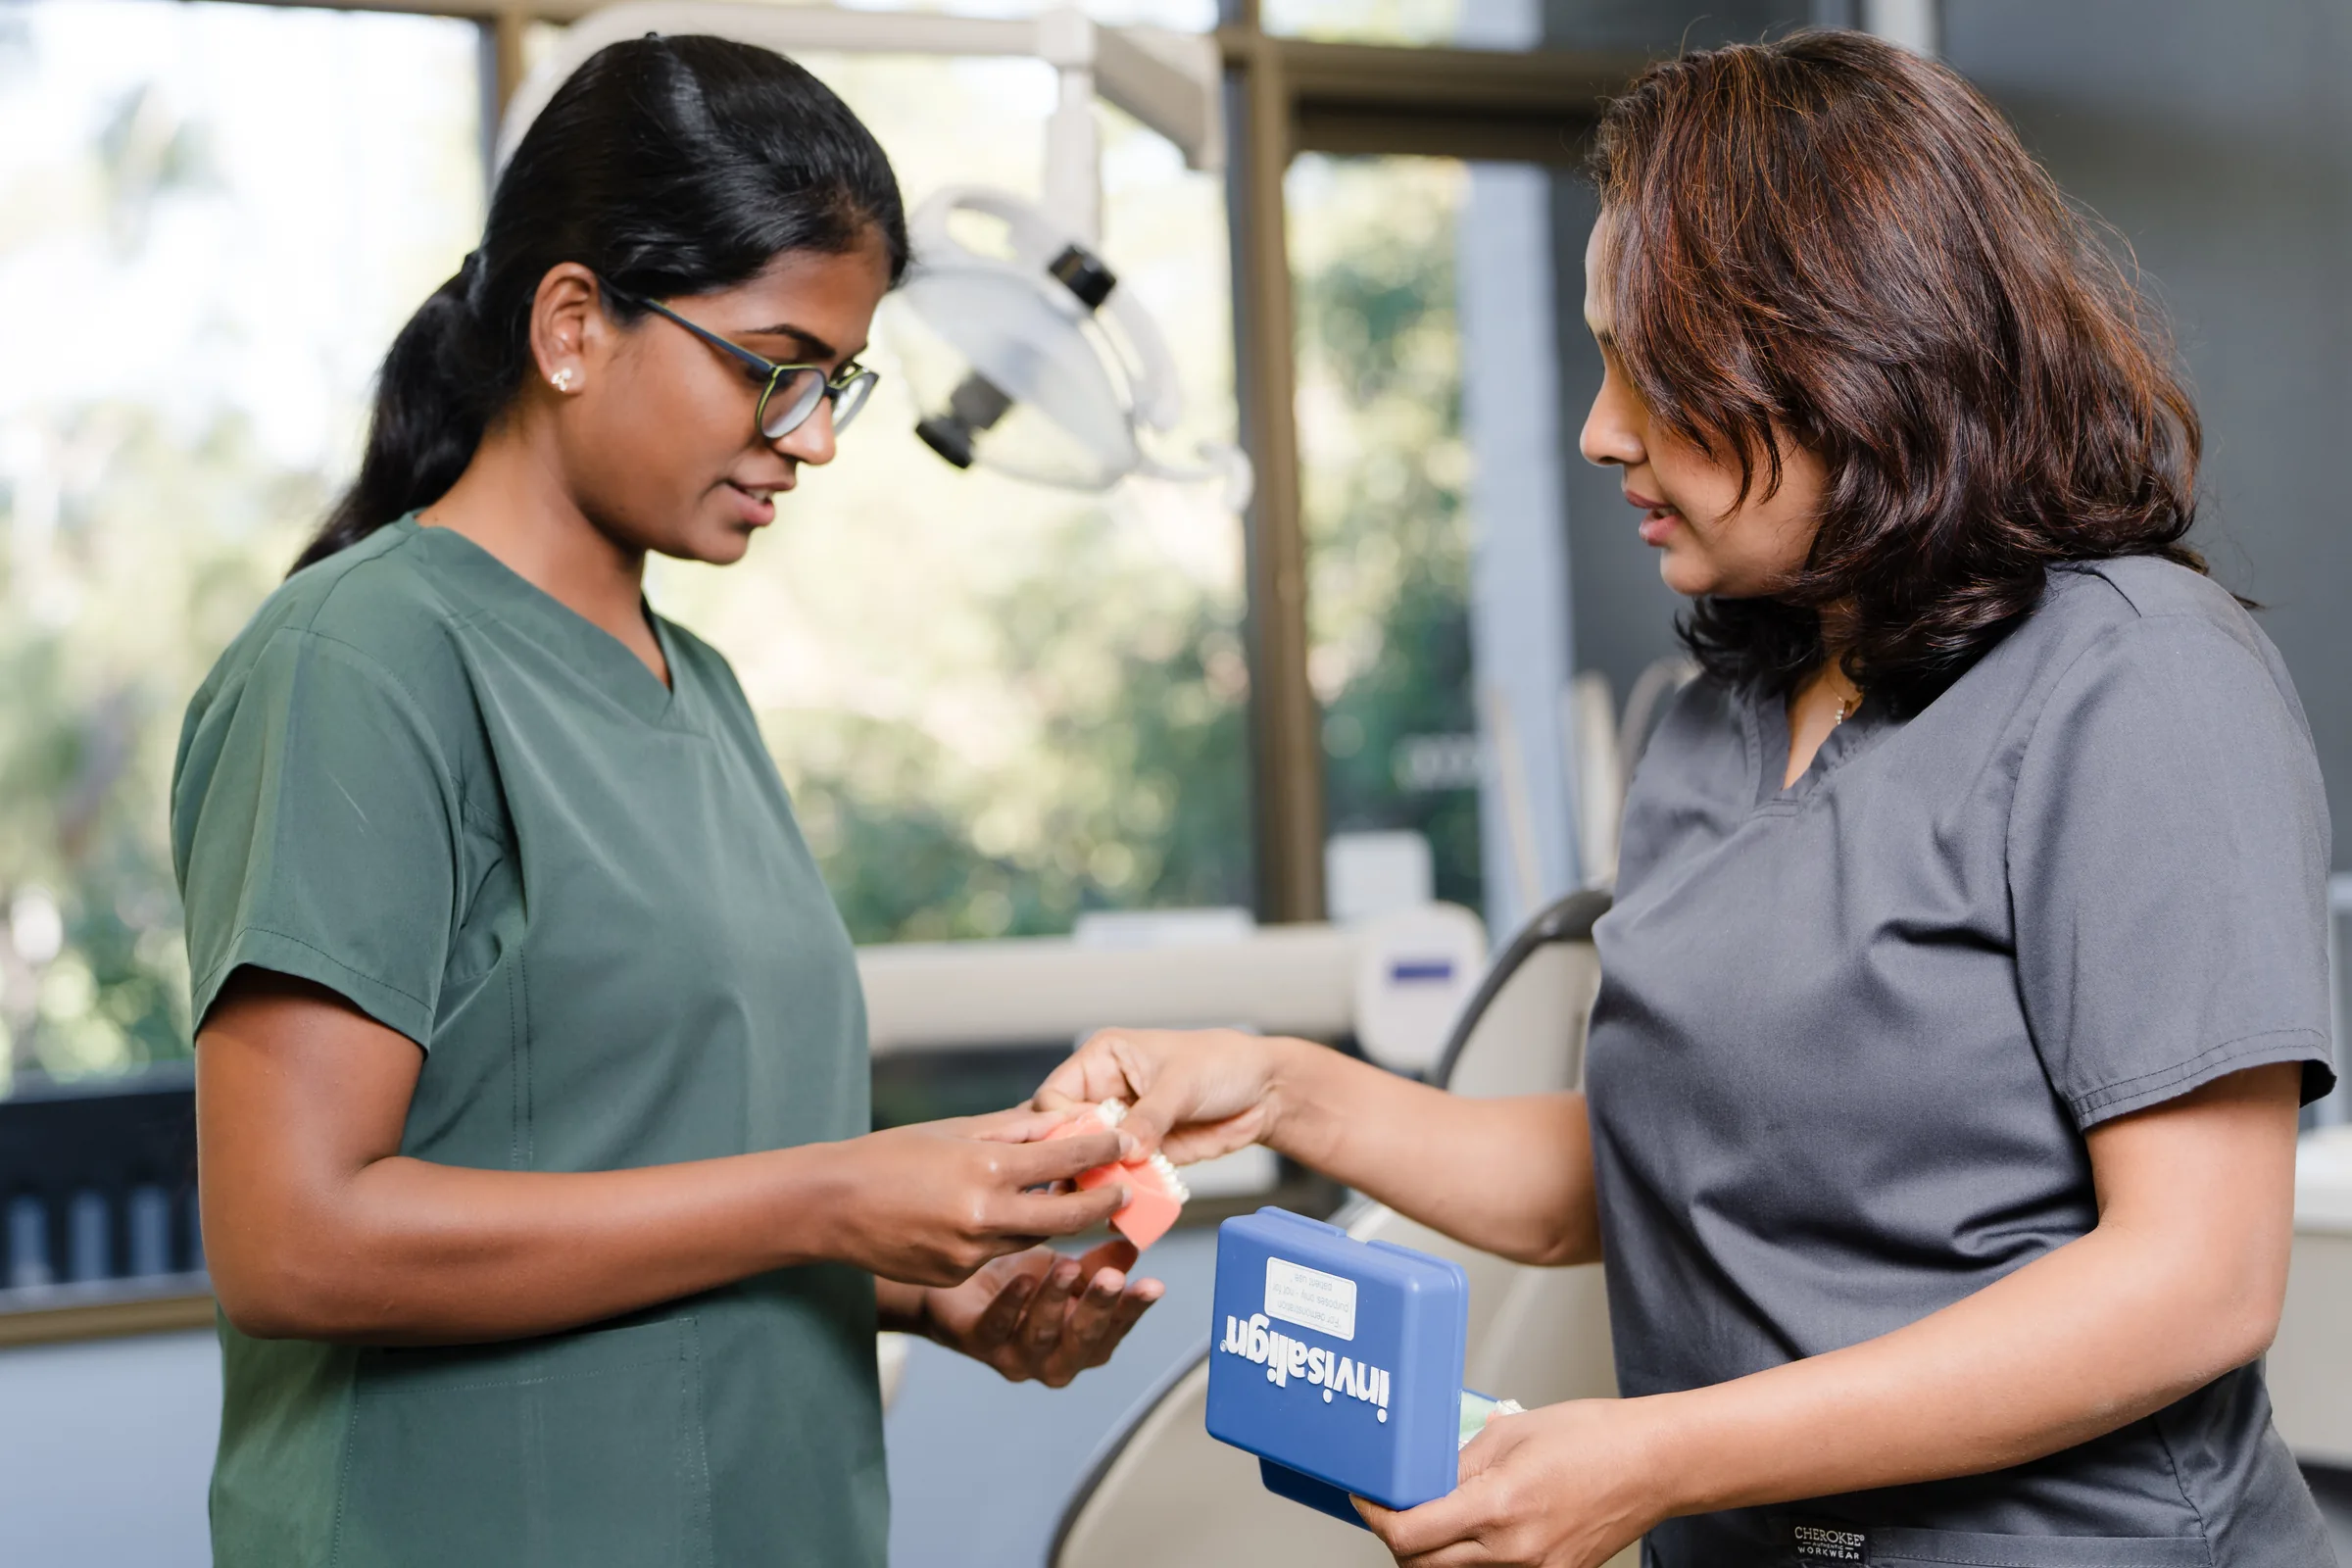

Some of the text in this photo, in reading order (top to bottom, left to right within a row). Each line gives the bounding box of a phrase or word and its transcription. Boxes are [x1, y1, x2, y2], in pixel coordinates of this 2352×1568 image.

[1283, 1286, 1295, 1296] not
[1309, 1277, 1333, 1291] patient
[1300, 1289, 1314, 1302] only
[1278, 1301, 1326, 1321] demonstration
[1316, 1297, 1349, 1313] purposes
[1797, 1546, 1860, 1560] WORKWEAR
[1812, 1542, 1843, 1550] AUTHENTIC
